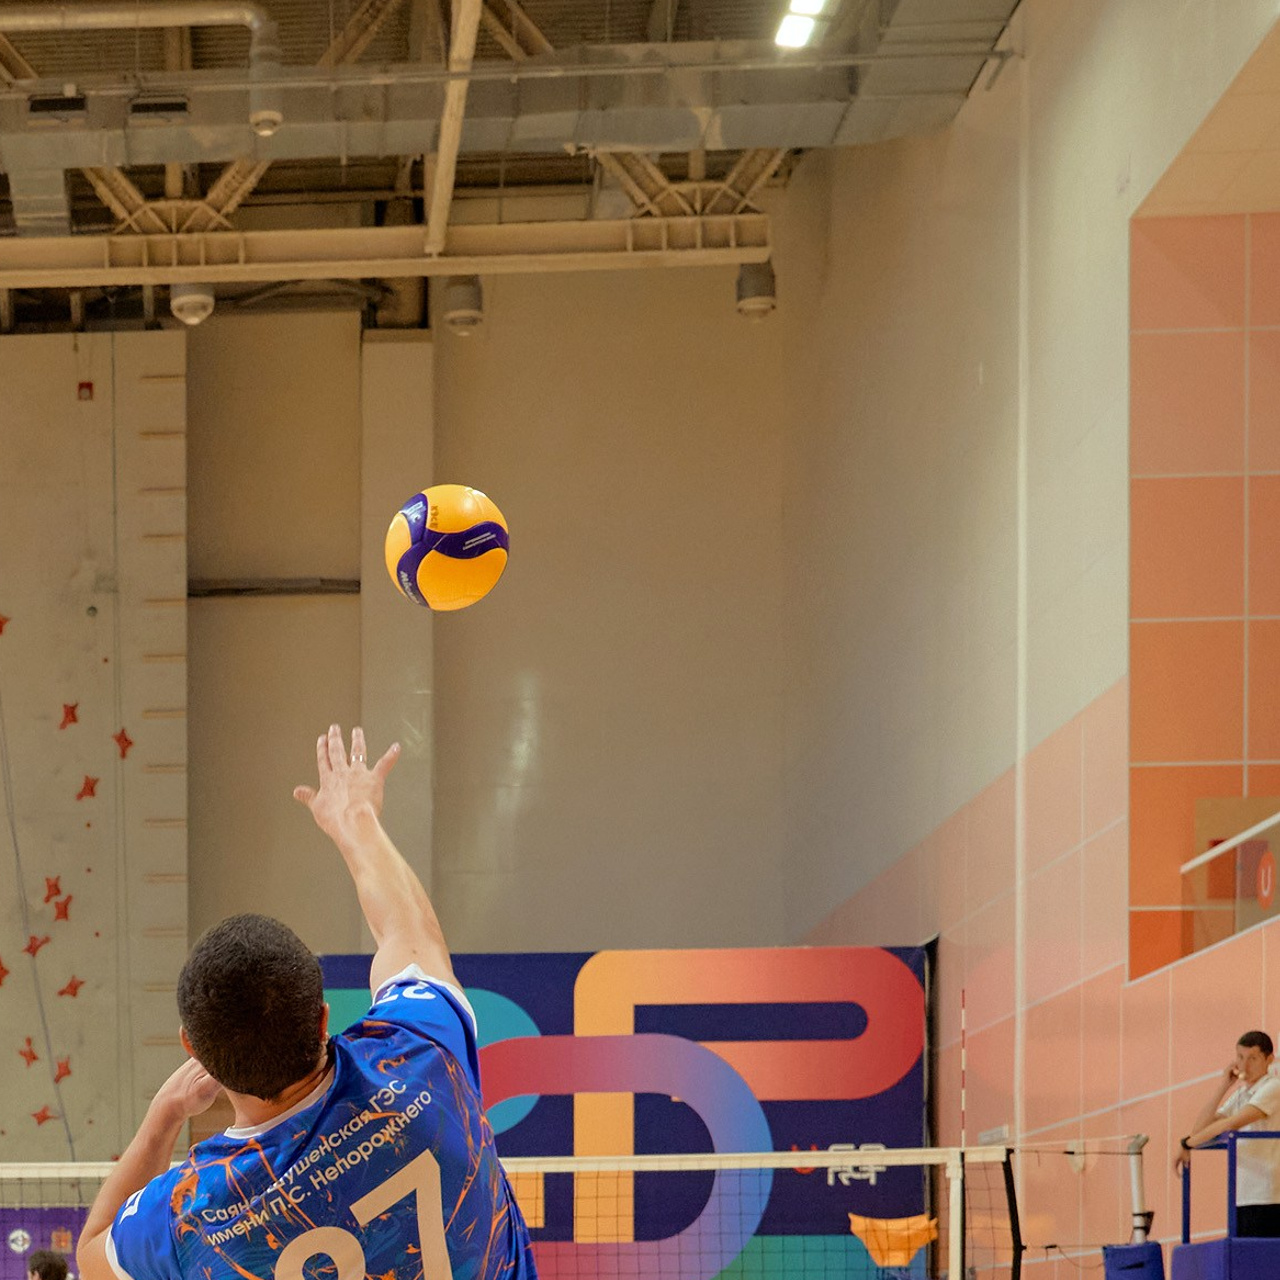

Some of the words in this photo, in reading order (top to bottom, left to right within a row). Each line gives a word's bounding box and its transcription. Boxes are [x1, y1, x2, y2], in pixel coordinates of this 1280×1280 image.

[368, 1079, 407, 1114] ГЭС
[207, 1209, 270, 1246] имени
[270, 1184, 312, 1216] П.С.
[309, 1091, 432, 1191] Непорожнего
